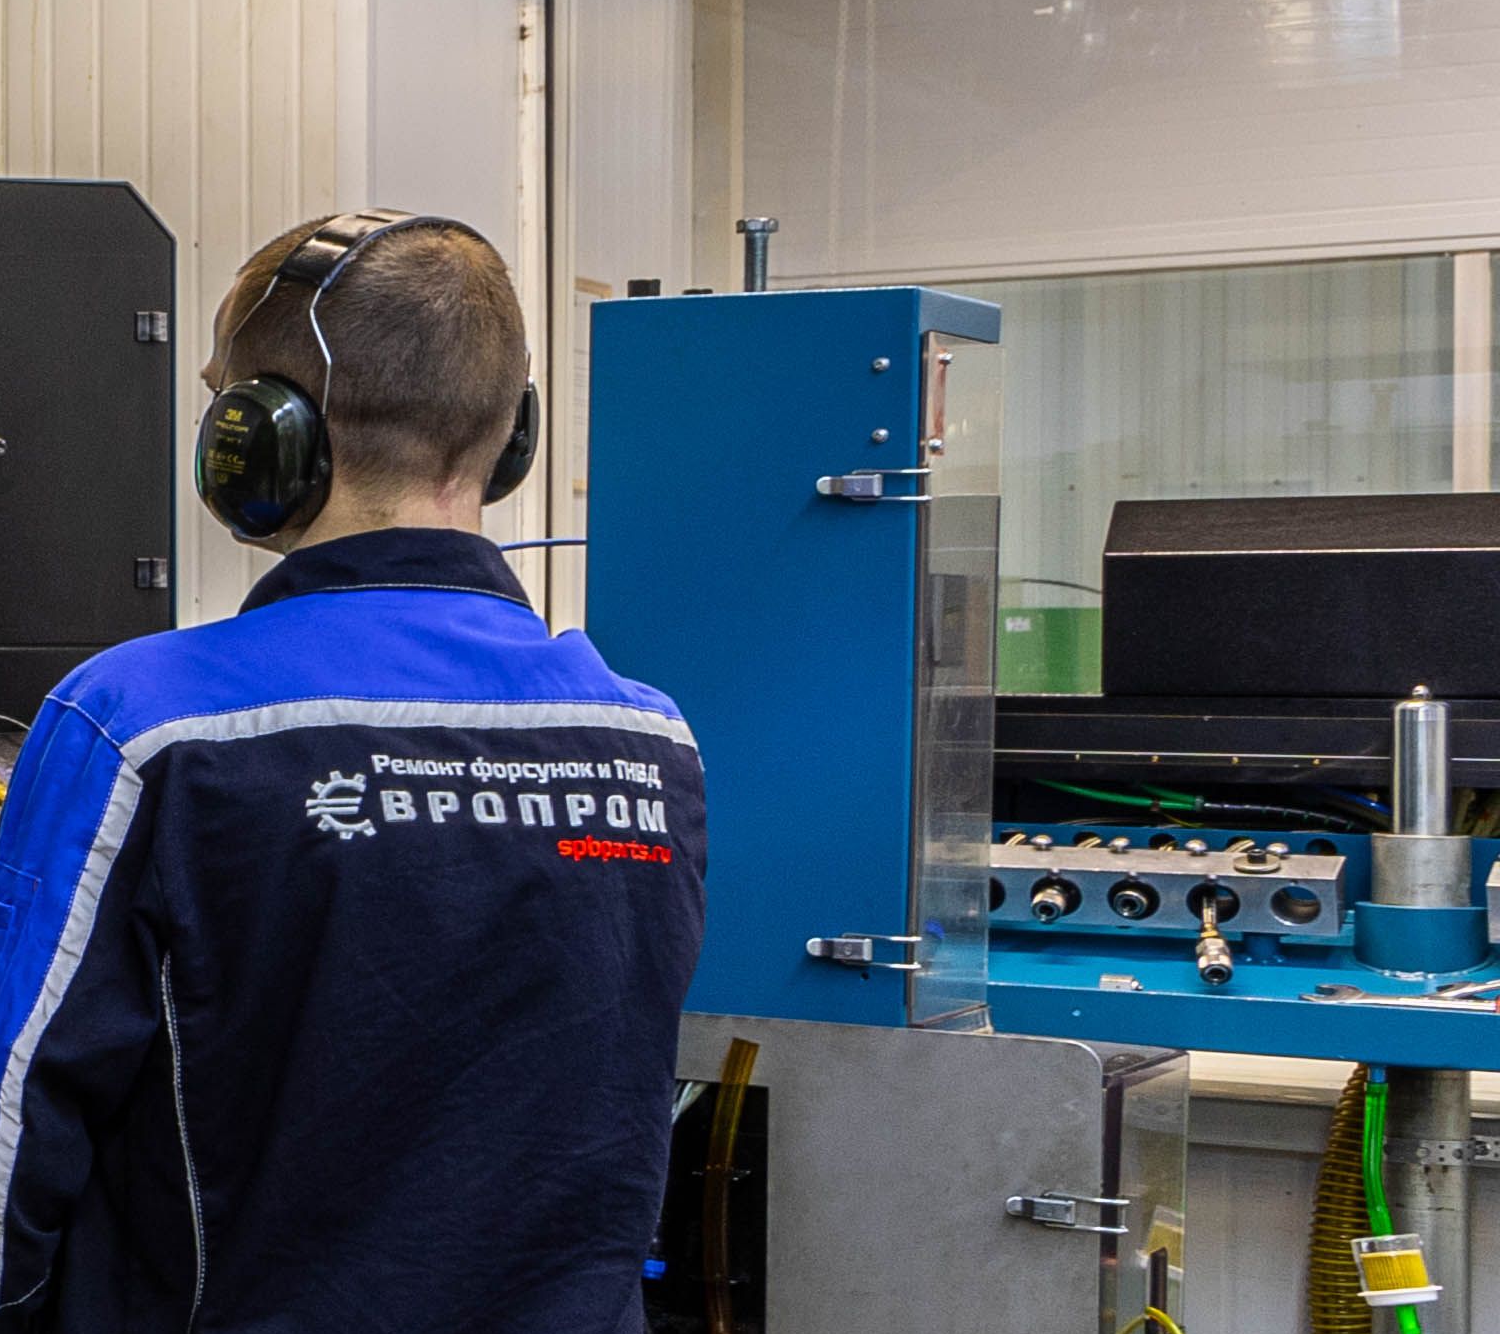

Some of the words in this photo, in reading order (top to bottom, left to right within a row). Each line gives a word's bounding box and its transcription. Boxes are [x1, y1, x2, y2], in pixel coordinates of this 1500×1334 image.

[371, 753, 467, 777] Ремонт
[470, 756, 595, 785] форсунок
[597, 762, 611, 778] и
[613, 759, 663, 789] ТНВД
[556, 835, 672, 865] spbparts.ru
